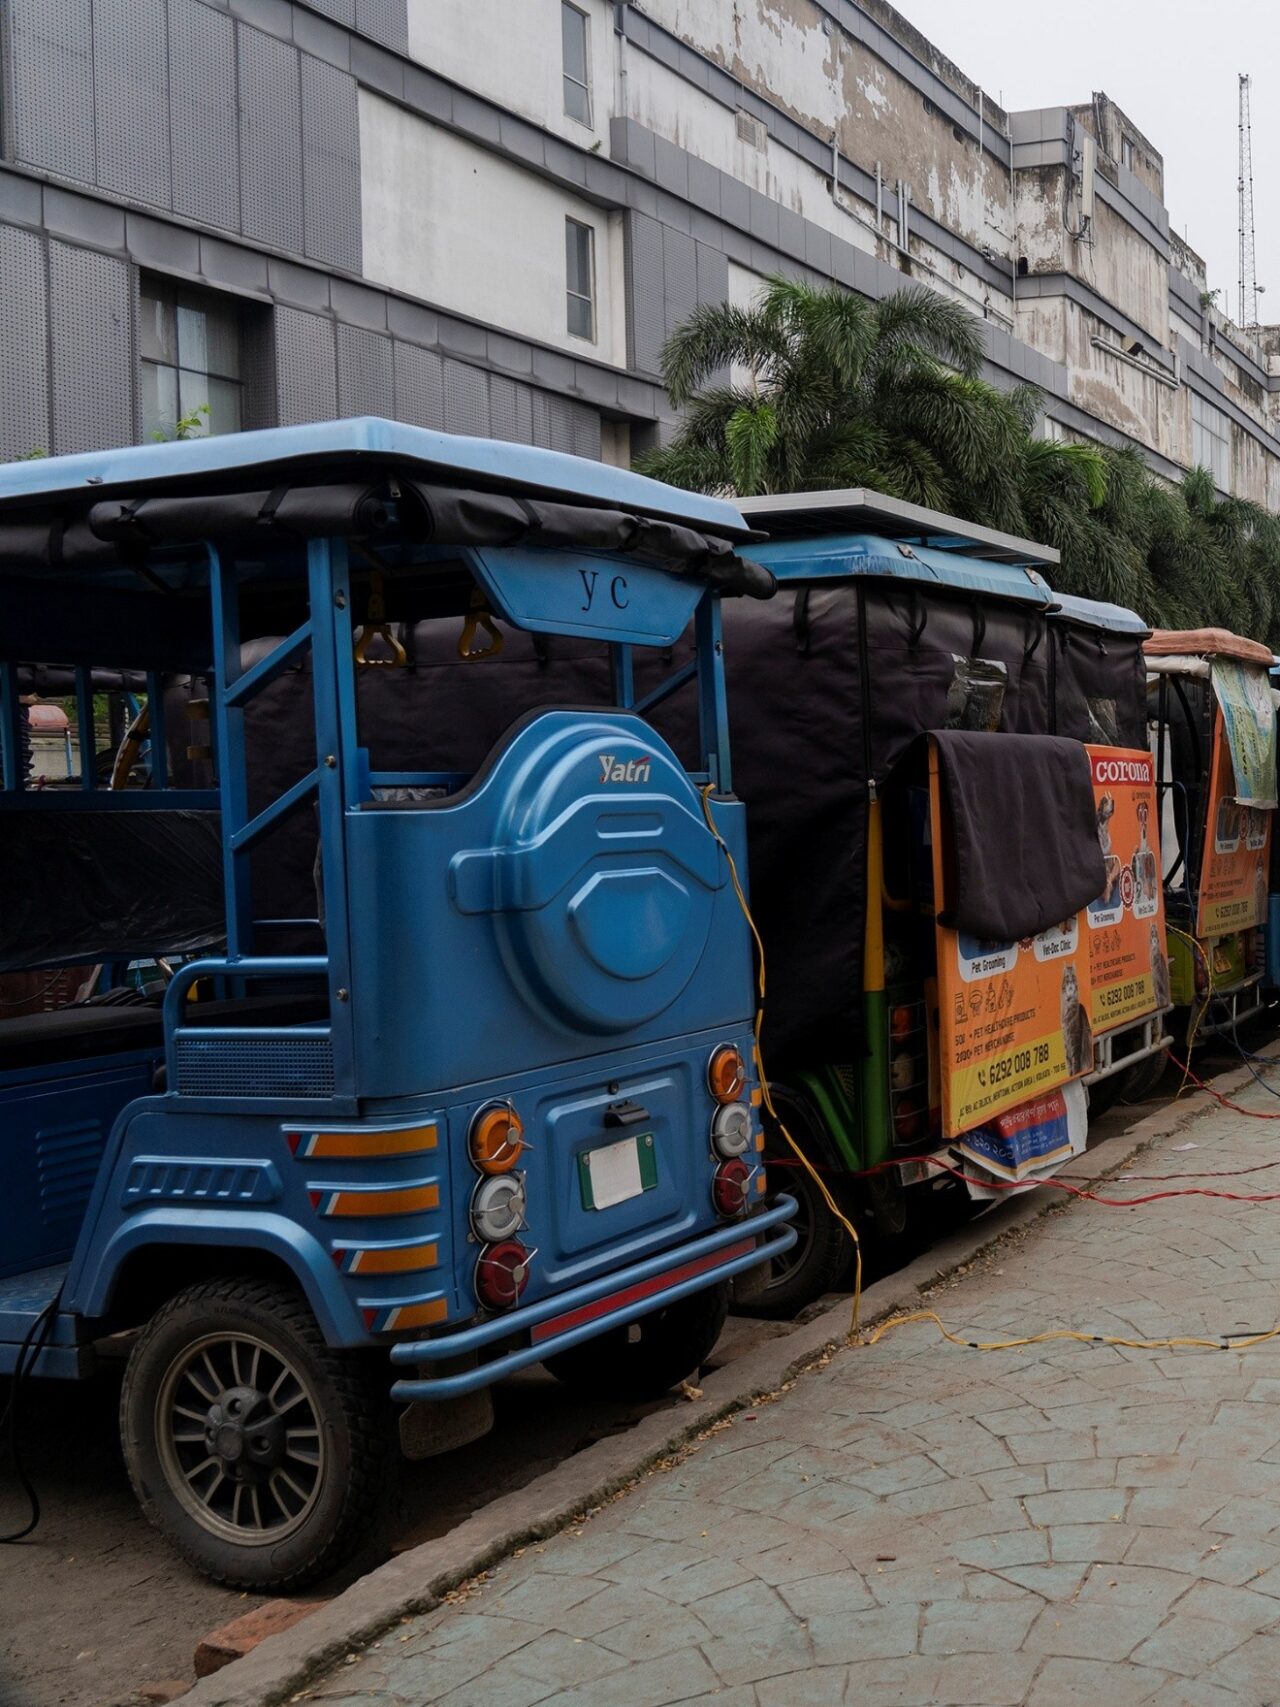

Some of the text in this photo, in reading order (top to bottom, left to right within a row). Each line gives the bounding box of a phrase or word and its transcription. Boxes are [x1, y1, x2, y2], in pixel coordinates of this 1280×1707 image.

[599, 755, 651, 784] Yatri
[1096, 760, 1150, 783] corona
[1042, 938, 1072, 956] Vet-Doc Clinic
[971, 956, 1006, 974] Pet Grooming
[1107, 987, 1122, 1006] 6292
[1123, 983, 1134, 1000] 008
[974, 1027, 983, 1039] PET
[1013, 1007, 1036, 1024] PRODUCTS
[974, 1044, 983, 1056] PET
[989, 1043, 1049, 1085] 6292 008 788
